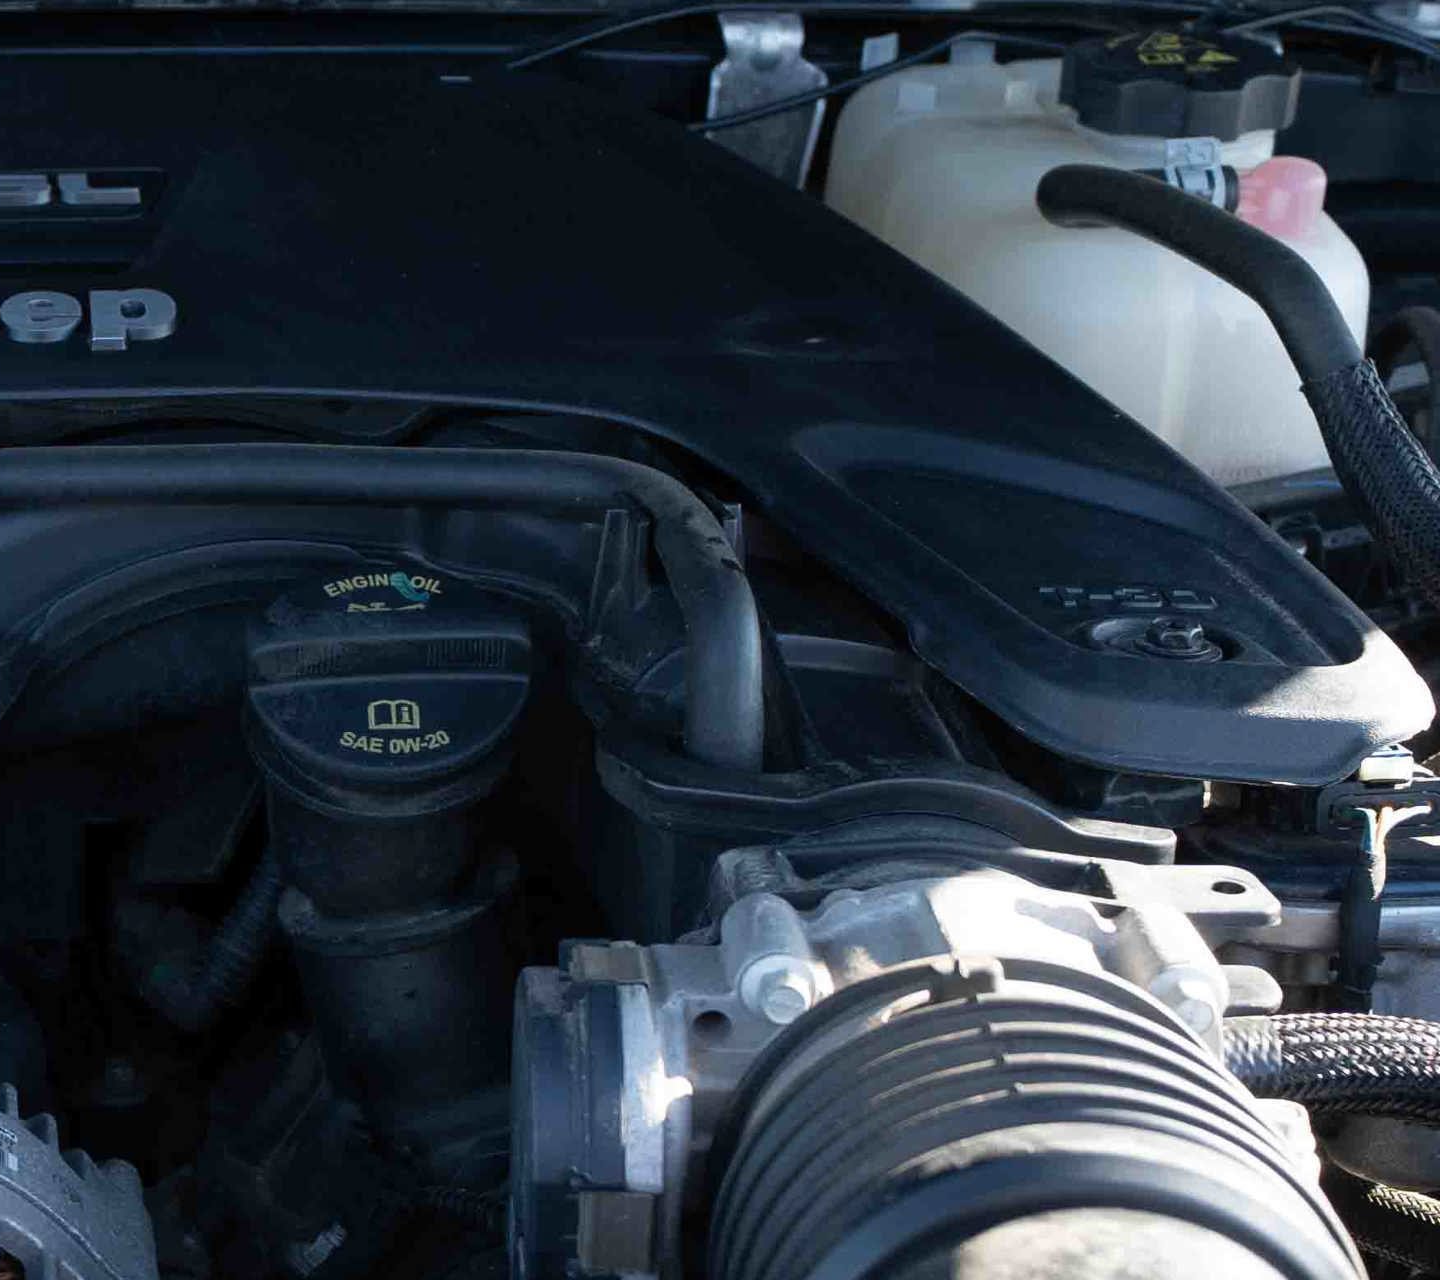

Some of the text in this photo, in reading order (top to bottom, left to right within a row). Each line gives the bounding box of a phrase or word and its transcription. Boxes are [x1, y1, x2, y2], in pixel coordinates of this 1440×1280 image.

[410, 576, 443, 594] OIL
[340, 730, 450, 754] SAE 0W-20
